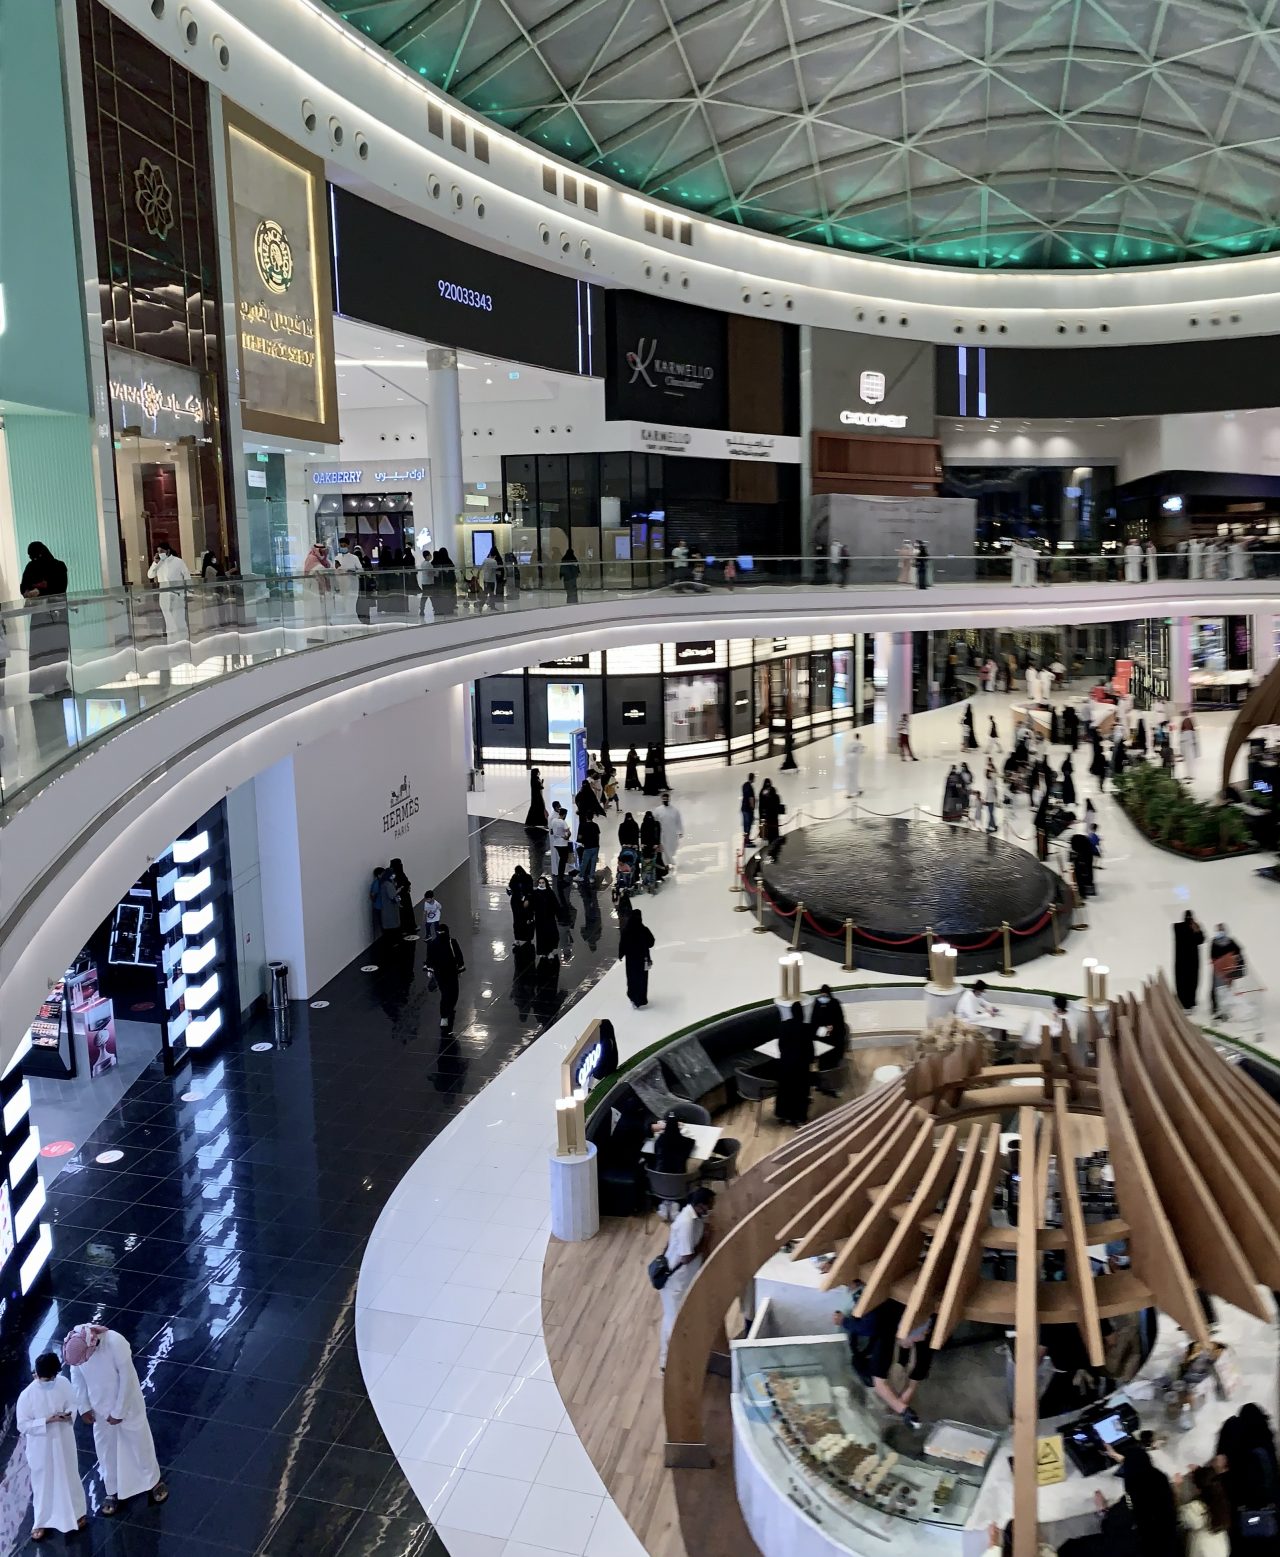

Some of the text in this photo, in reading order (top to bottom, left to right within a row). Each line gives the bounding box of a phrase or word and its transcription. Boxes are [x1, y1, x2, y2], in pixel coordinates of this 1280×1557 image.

[438, 280, 493, 312] 920033343
[312, 470, 362, 484] OAKBERRY
[394, 822, 410, 841] PARIS
